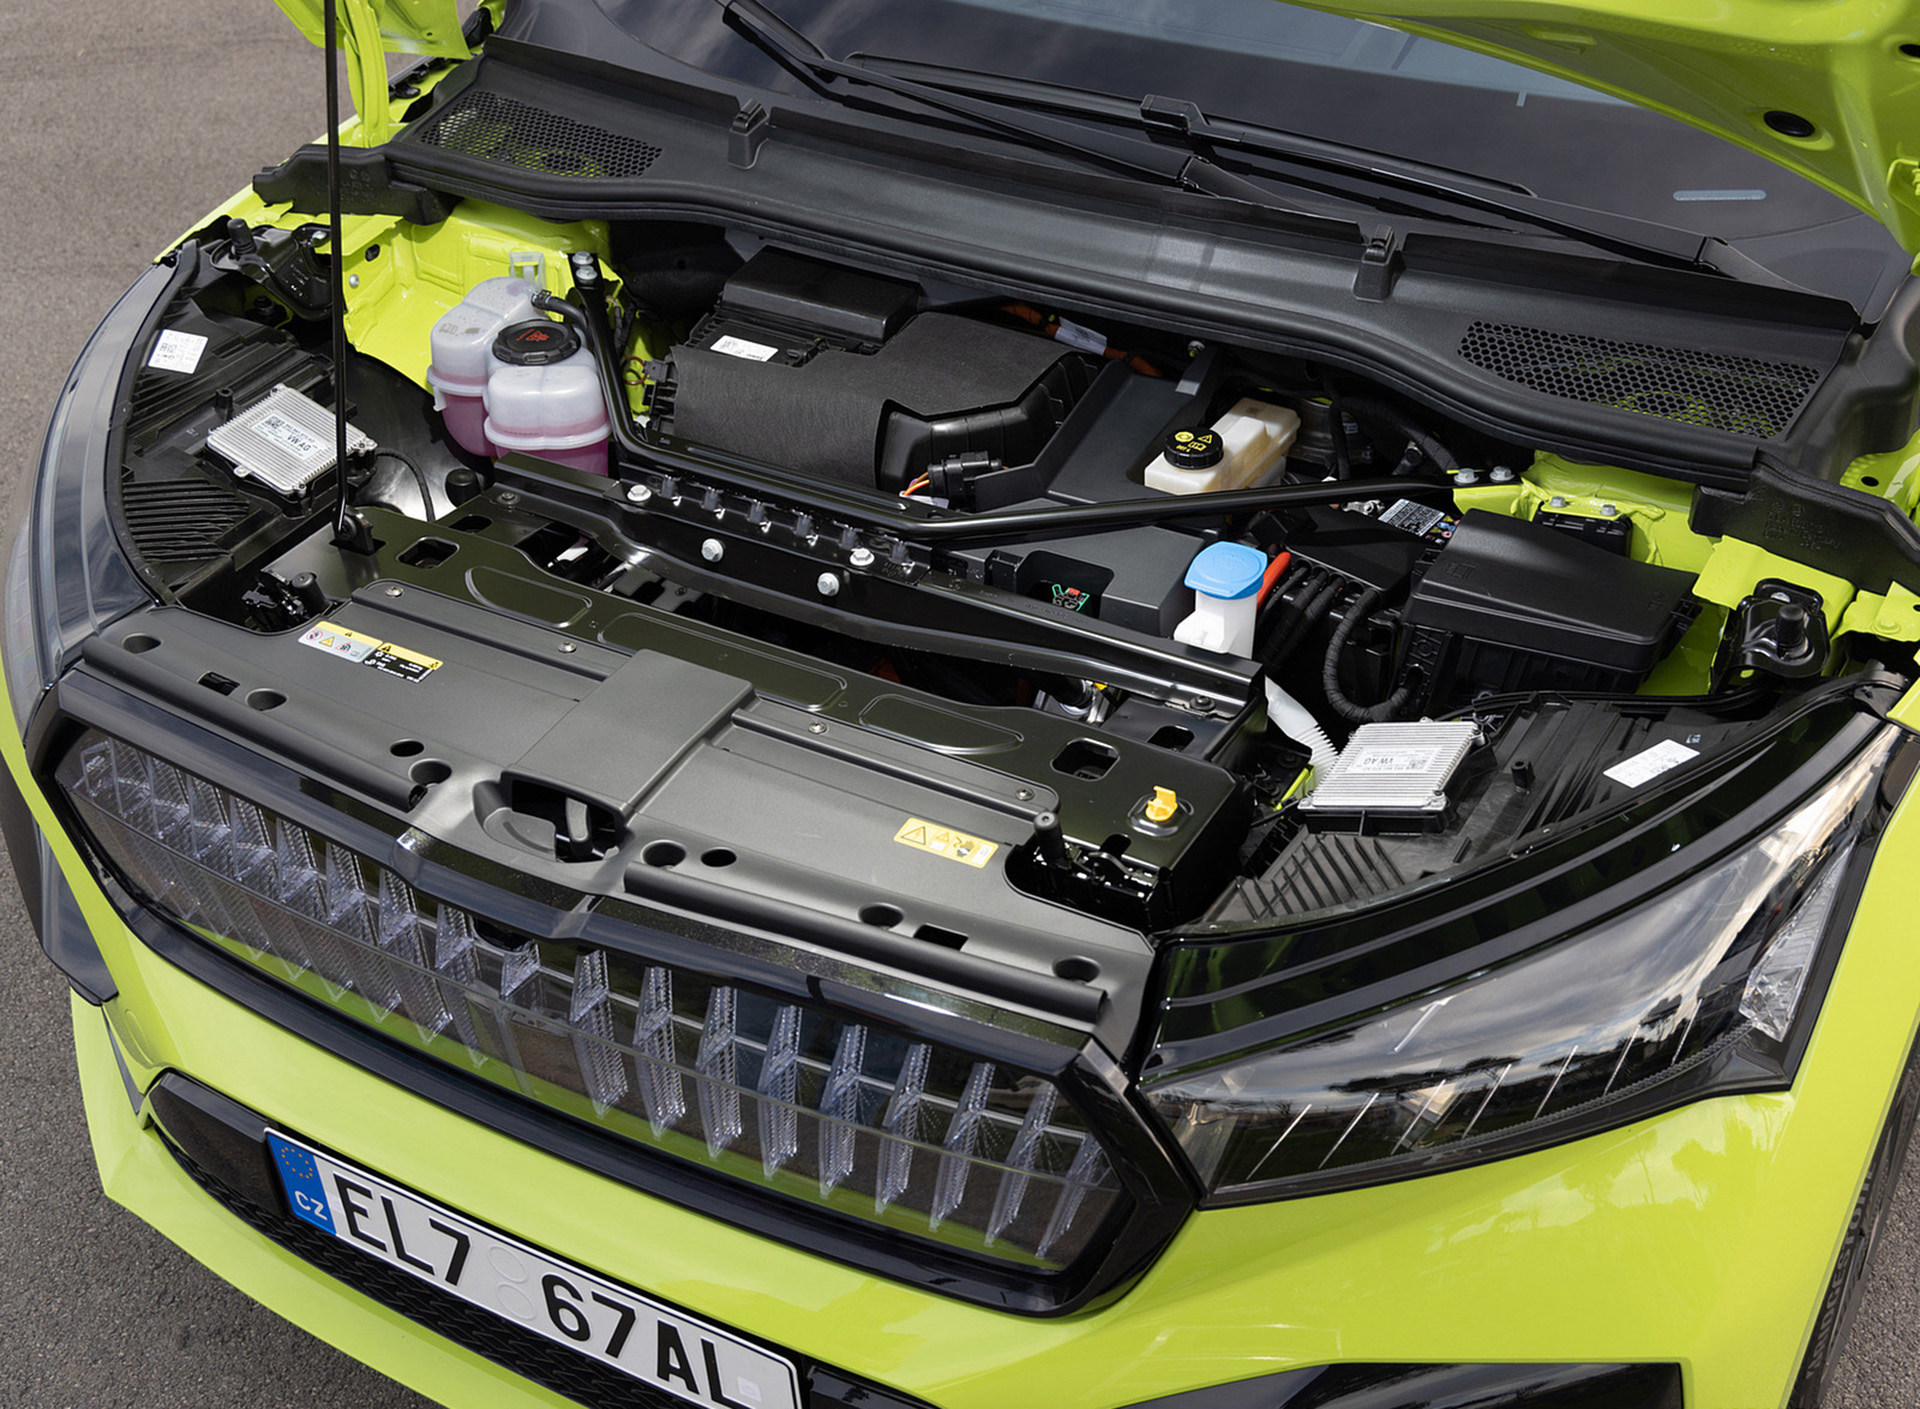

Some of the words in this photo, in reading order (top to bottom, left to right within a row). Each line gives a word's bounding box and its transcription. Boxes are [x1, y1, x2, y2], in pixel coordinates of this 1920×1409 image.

[287, 434, 300, 444] VW
[299, 442, 312, 451] AG
[295, 1190, 328, 1220] CZ
[333, 1172, 471, 1286] EL7
[541, 1274, 753, 1409] 67AL
